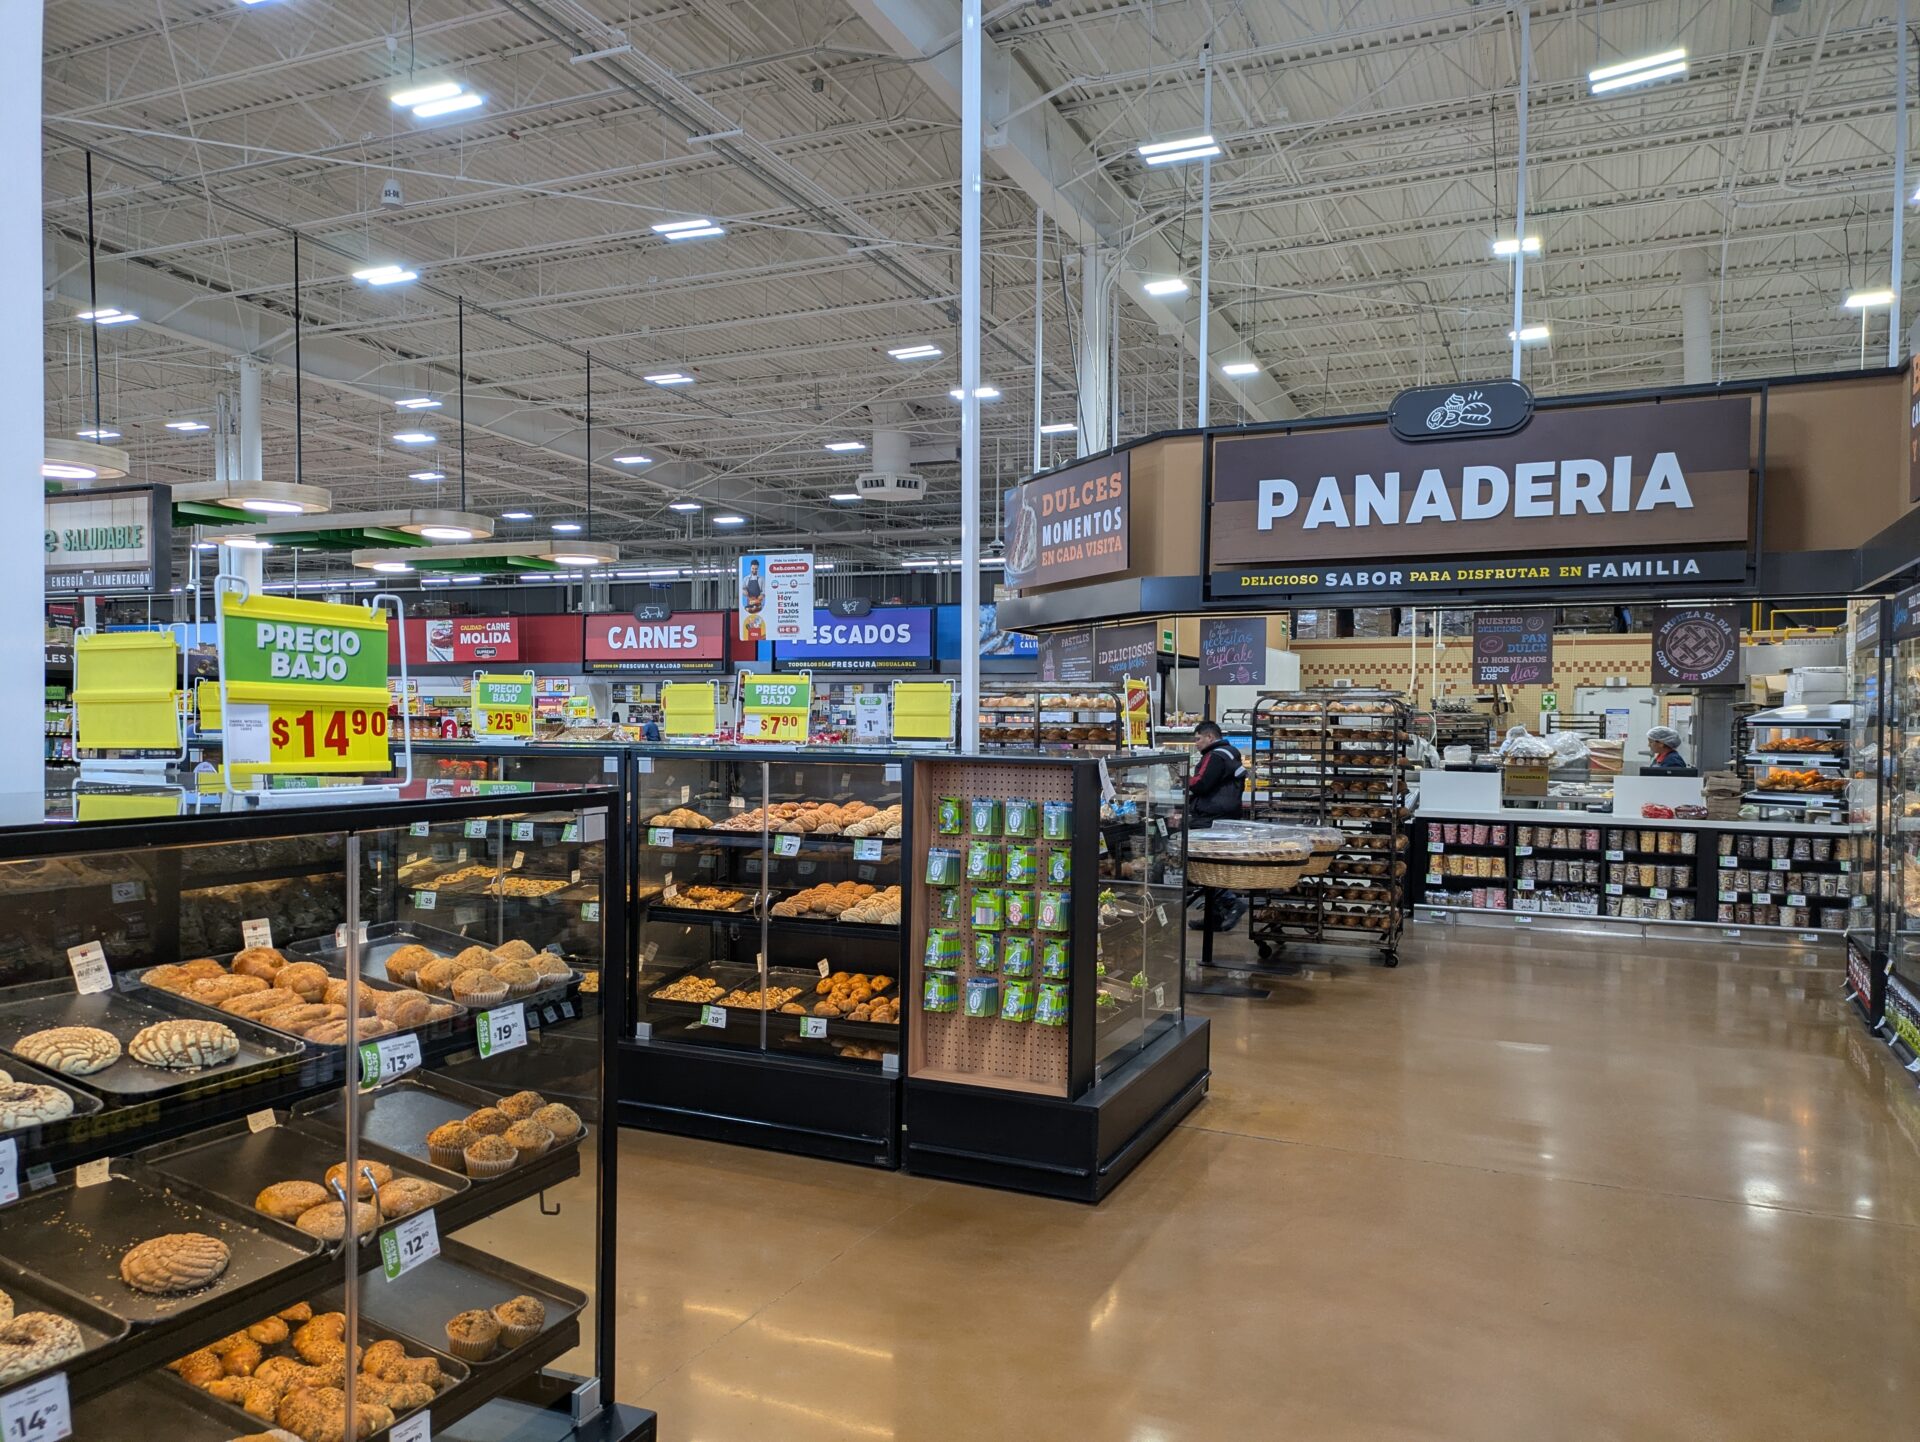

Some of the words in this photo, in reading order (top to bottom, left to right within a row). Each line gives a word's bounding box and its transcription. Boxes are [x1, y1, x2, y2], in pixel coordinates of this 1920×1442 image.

[1042, 472, 1122, 517] DULCES
[1257, 452, 1694, 531] PANADERIA
[1042, 506, 1122, 547] MOMENTOS
[63, 525, 144, 552] SALUDABLE
[1042, 550, 1055, 566] EN
[1056, 544, 1083, 562] CADA
[1085, 535, 1122, 556] VISITA
[52, 575, 83, 587] ENERGÍA
[93, 572, 150, 586] ALIMENTACIÓN
[1241, 574, 1319, 587] DELICIOSO
[1325, 571, 1402, 587] SABOR
[1409, 570, 1451, 582] PARA
[1457, 567, 1550, 580] DISFRUTAR
[1559, 566, 1582, 577] EN
[1587, 559, 1700, 579] FAMILIA
[486, 622, 510, 631] CARNE
[1477, 617, 1523, 625] NUESTRO
[1477, 625, 1522, 633] DELICIOSO
[1660, 611, 1700, 635] EMPIEZA
[1704, 612, 1715, 621] EL
[256, 622, 361, 656] PRECIO
[460, 632, 511, 645] MOLIDA
[607, 625, 698, 650] CARNES
[792, 624, 911, 645] ESCADOS
[1061, 633, 1090, 648] PASTELES
[1521, 633, 1547, 643] PAN
[1020, 641, 1038, 649] CALI
[1098, 640, 1155, 665] ¡DELICIOSOS!
[1507, 643, 1548, 653] DULCE
[270, 652, 347, 681] BAJO
[1656, 650, 1670, 669] CON
[1668, 667, 1679, 677] EL
[1701, 650, 1735, 680] DERECHO
[488, 684, 522, 694] PRECIO
[492, 693, 518, 703] BAJO
[755, 685, 796, 696] PRECIO
[760, 695, 791, 706] BAJO
